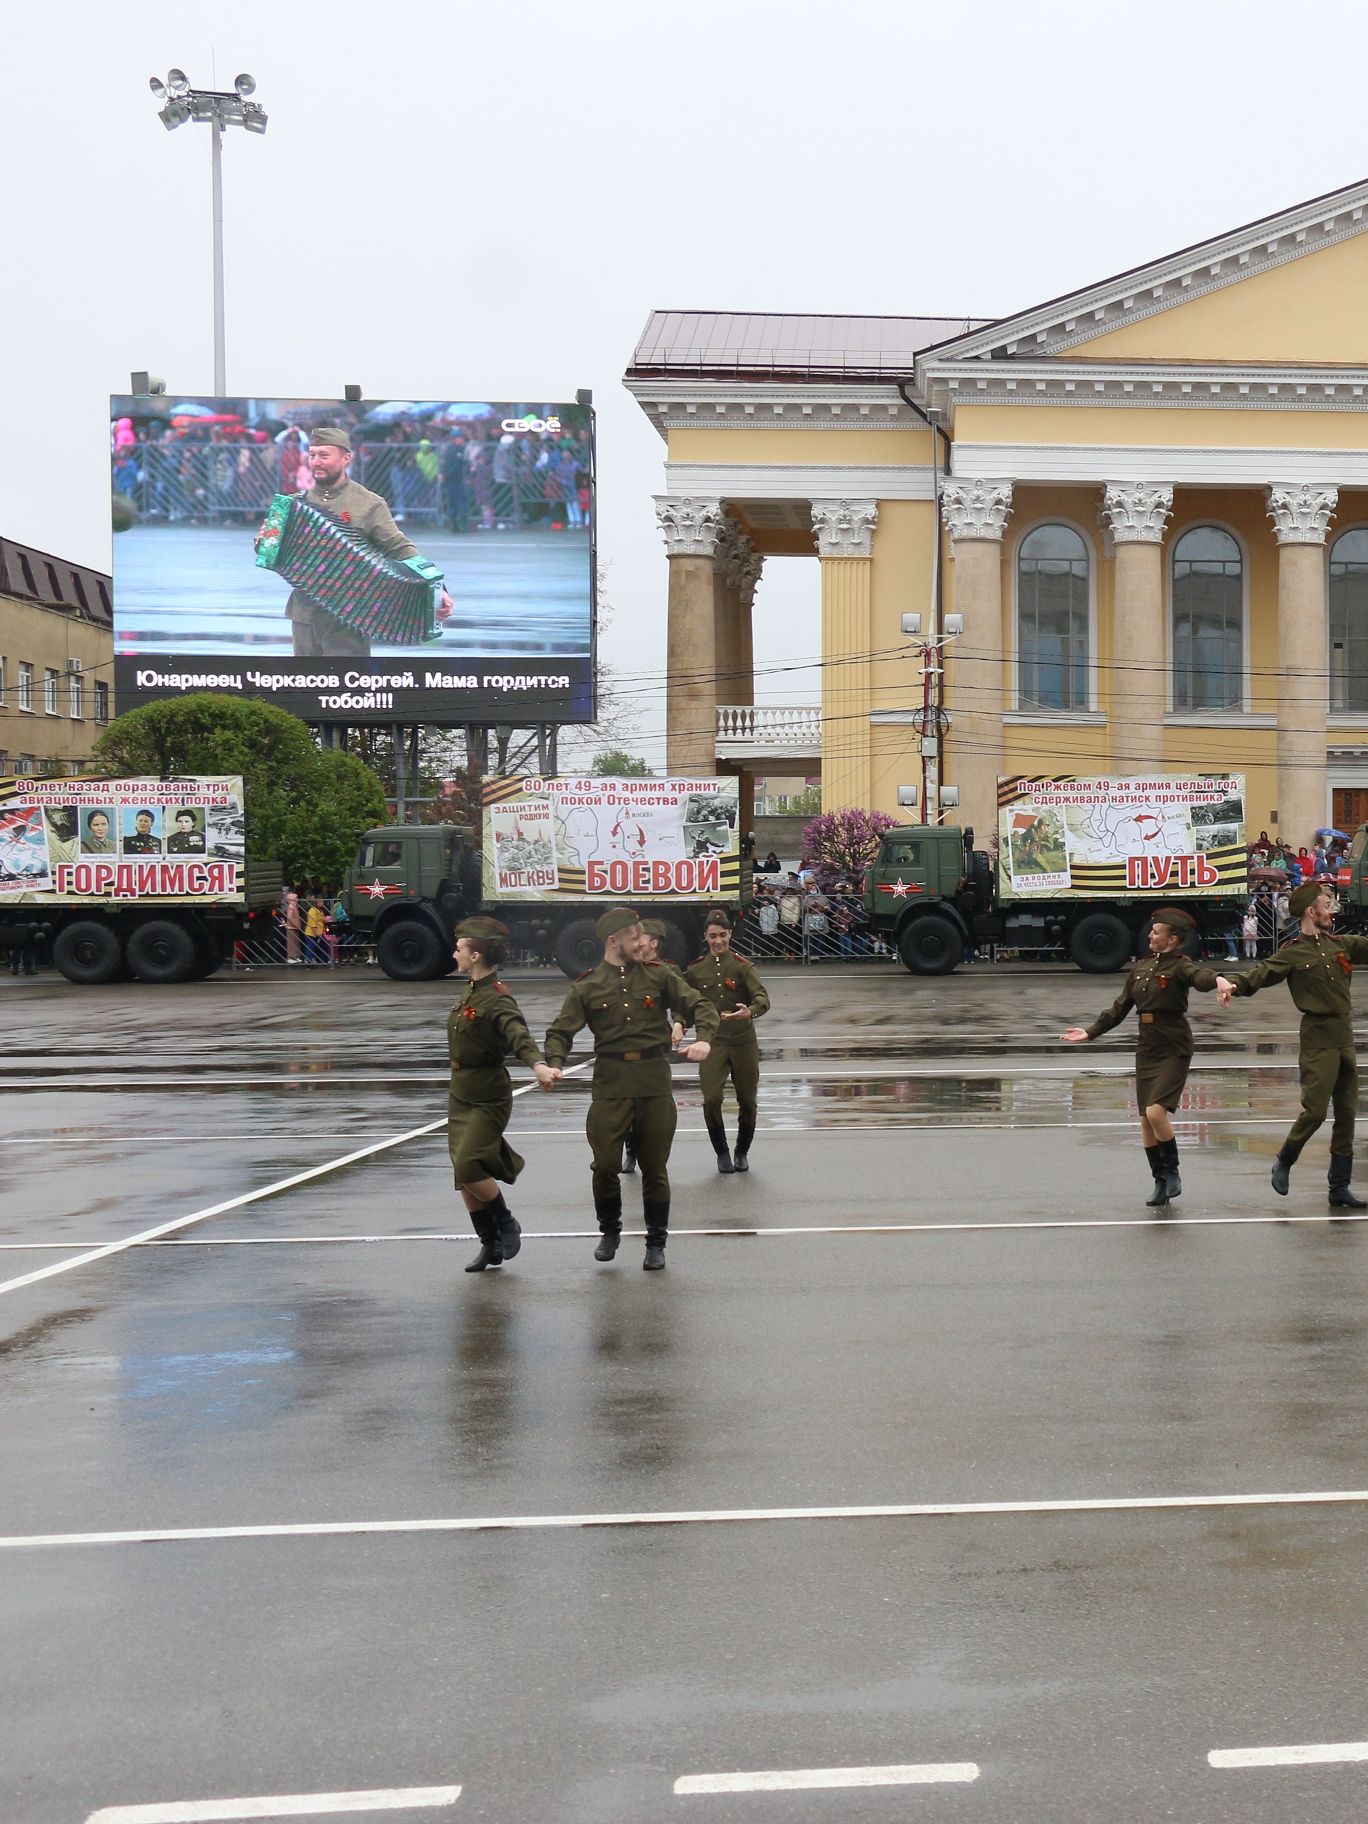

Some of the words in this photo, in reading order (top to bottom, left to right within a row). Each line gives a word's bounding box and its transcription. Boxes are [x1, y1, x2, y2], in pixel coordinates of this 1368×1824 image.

[137, 671, 242, 690] Юнармеец
[247, 671, 339, 691] Черкасов
[344, 671, 419, 690] Сергей.
[425, 672, 478, 688] Мама
[483, 675, 570, 691] гордится
[318, 693, 393, 709] тобой!!!
[17, 781, 35, 792] 80
[39, 783, 63, 792] лет
[68, 783, 110, 793] назад
[115, 782, 199, 793] образованы
[205, 783, 229, 794] три
[524, 780, 542, 791] 80
[546, 782, 570, 791] лет
[575, 780, 616, 792] 49-ая
[621, 783, 665, 794] армия
[670, 782, 718, 794] хранит
[1019, 782, 1041, 793] Под
[1045, 781, 1091, 792] Ржевом
[1095, 781, 1130, 791] 49-ая
[1135, 782, 1171, 792] армия
[1175, 780, 1213, 791] целый
[1218, 781, 1238, 791] год
[20, 796, 114, 806] авиационных
[120, 795, 181, 805] женских
[186, 796, 228, 805] полка
[561, 795, 602, 806] покой
[607, 794, 678, 806] Отечества
[1034, 795, 1107, 806] сдерживала
[1111, 794, 1153, 804] натиск
[1155, 793, 1223, 804] противника
[495, 804, 549, 814] ЗАЩИТИМ
[519, 813, 550, 821] РОДНУЮ
[588, 853, 719, 891] БОЕВОЙ
[1128, 855, 1218, 887] ПУТЬ
[57, 863, 236, 897] ГОРДИМСЯ!
[499, 870, 555, 888] МОСКВУ
